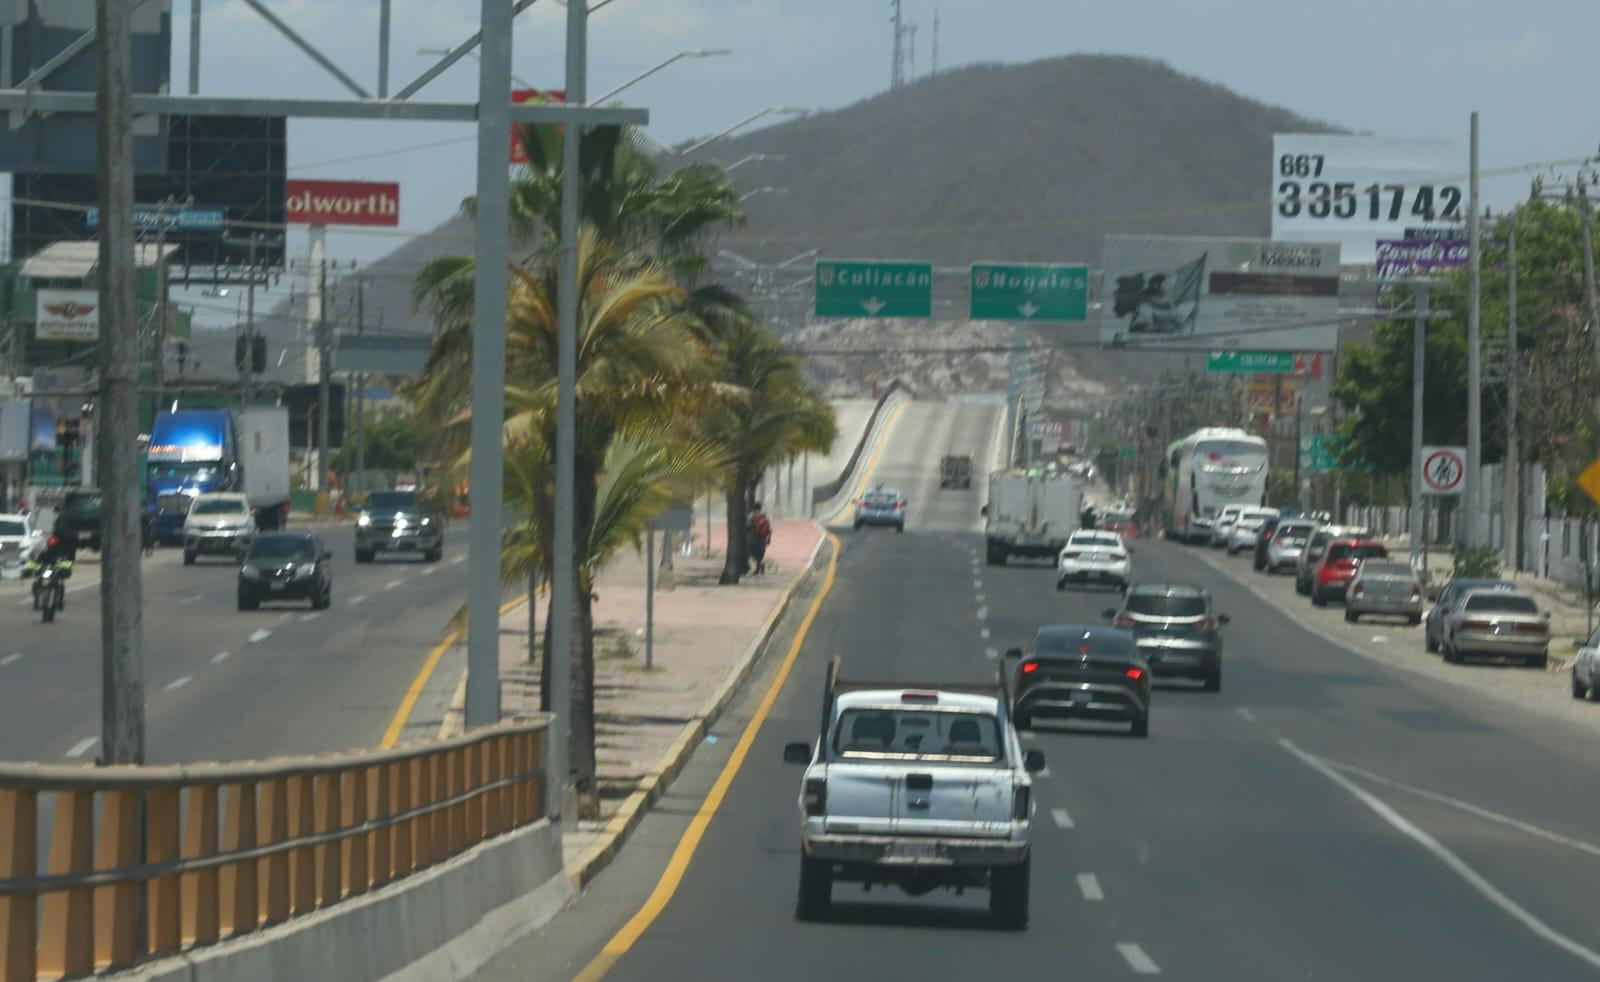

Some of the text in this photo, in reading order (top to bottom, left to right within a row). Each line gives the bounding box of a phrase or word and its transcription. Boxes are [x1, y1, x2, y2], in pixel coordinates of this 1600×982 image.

[1280, 154, 1325, 178] 667
[837, 267, 930, 287] Culiacán
[993, 271, 1085, 292] Nogales
